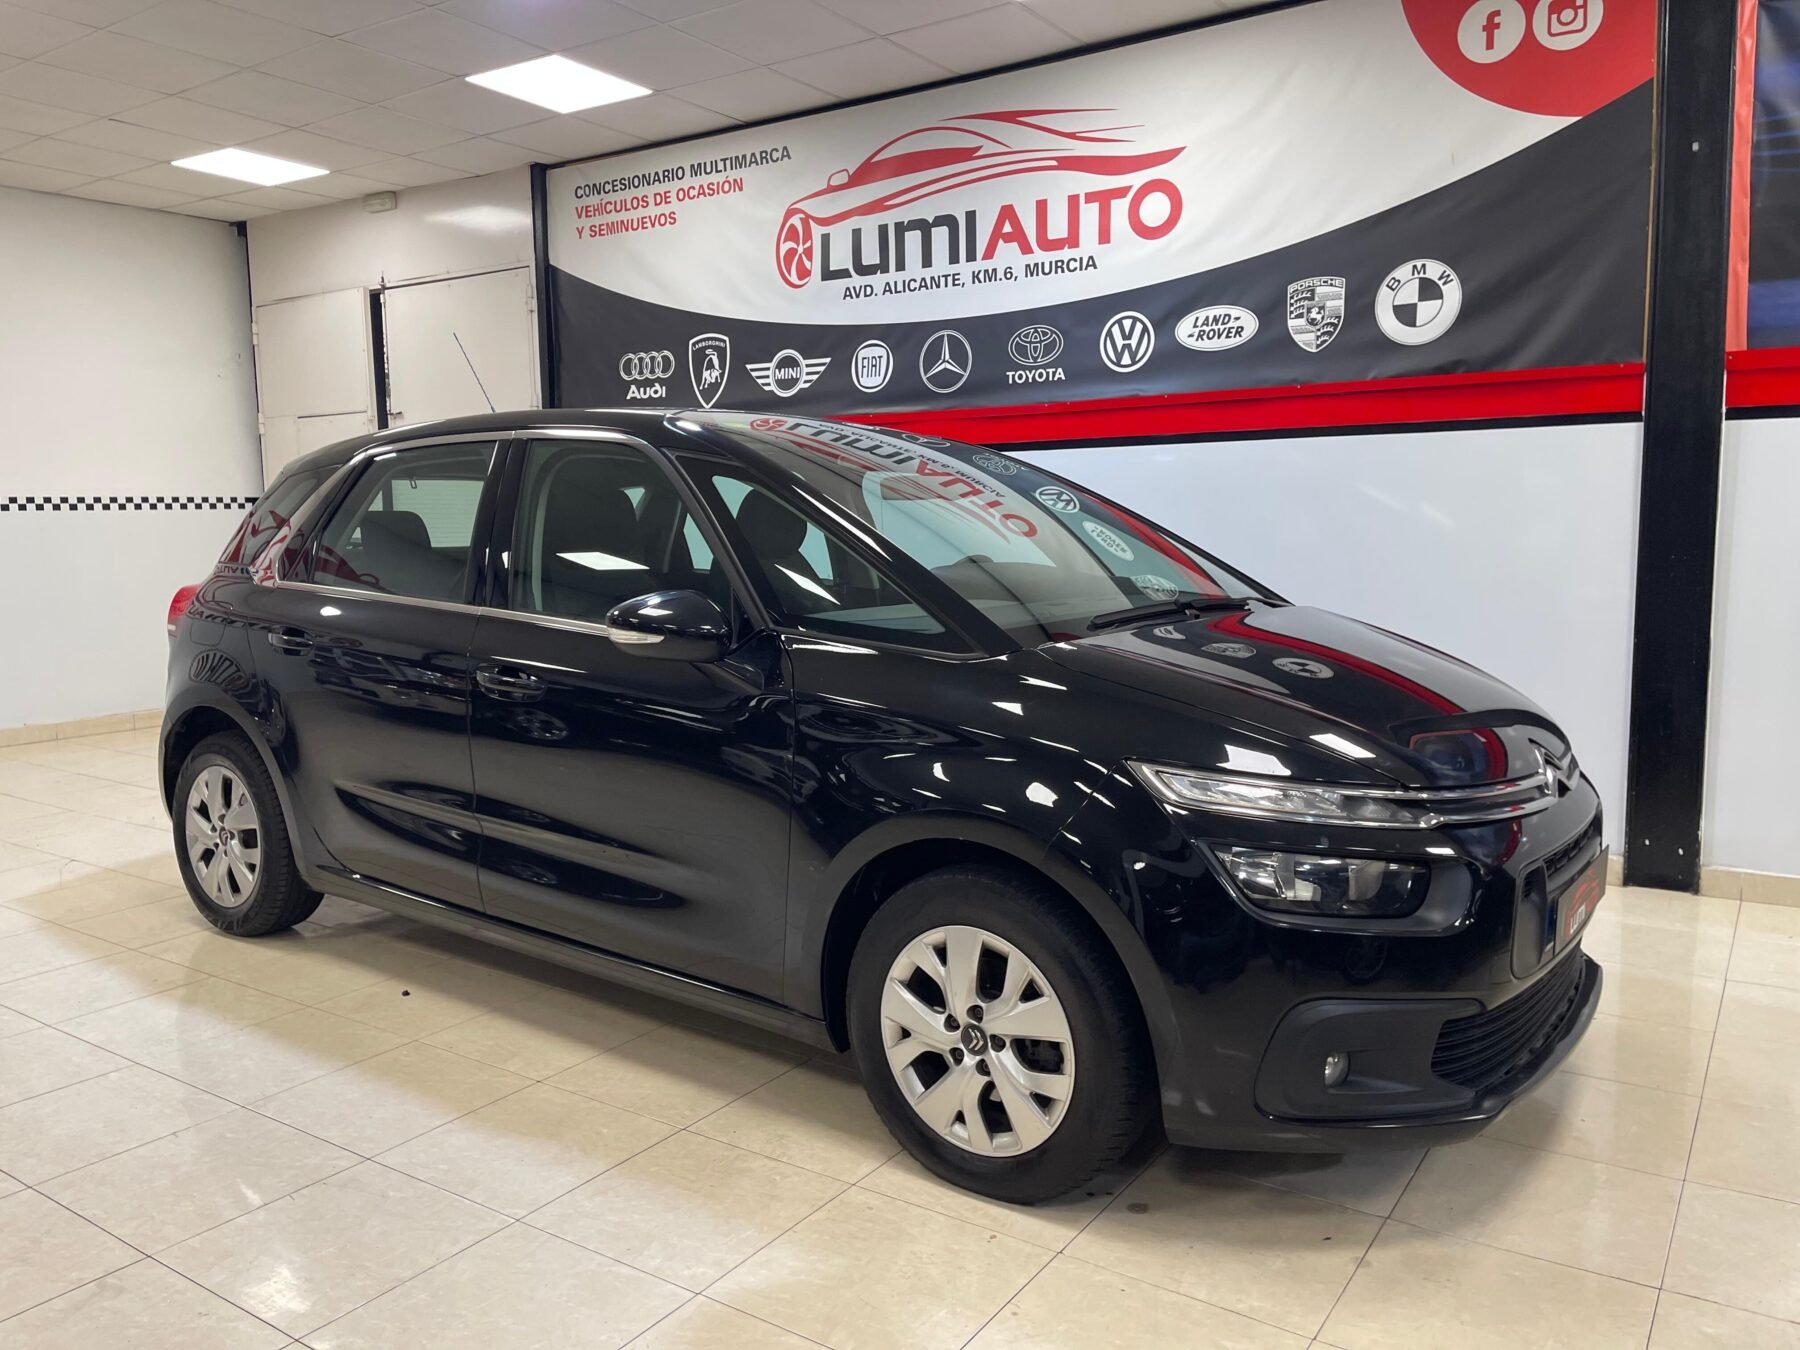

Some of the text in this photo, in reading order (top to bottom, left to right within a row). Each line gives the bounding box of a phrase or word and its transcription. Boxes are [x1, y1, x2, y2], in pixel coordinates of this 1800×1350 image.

[574, 145, 792, 199] CONCESIONARIO MULTIMARCA
[575, 176, 744, 220] VEHÍCULOS DE OCASIÓN
[576, 211, 678, 240] Y SEMINUEVOS
[842, 255, 1099, 301] AVD. ALICANTE, KM.6, MURCIA
[1290, 278, 1343, 293] PORSCHE
[1385, 263, 1454, 292] BMW
[775, 366, 801, 380] MINI
[861, 354, 884, 379] FIAT
[1006, 367, 1066, 385] TOYOTA
[626, 382, 666, 400] Audi
